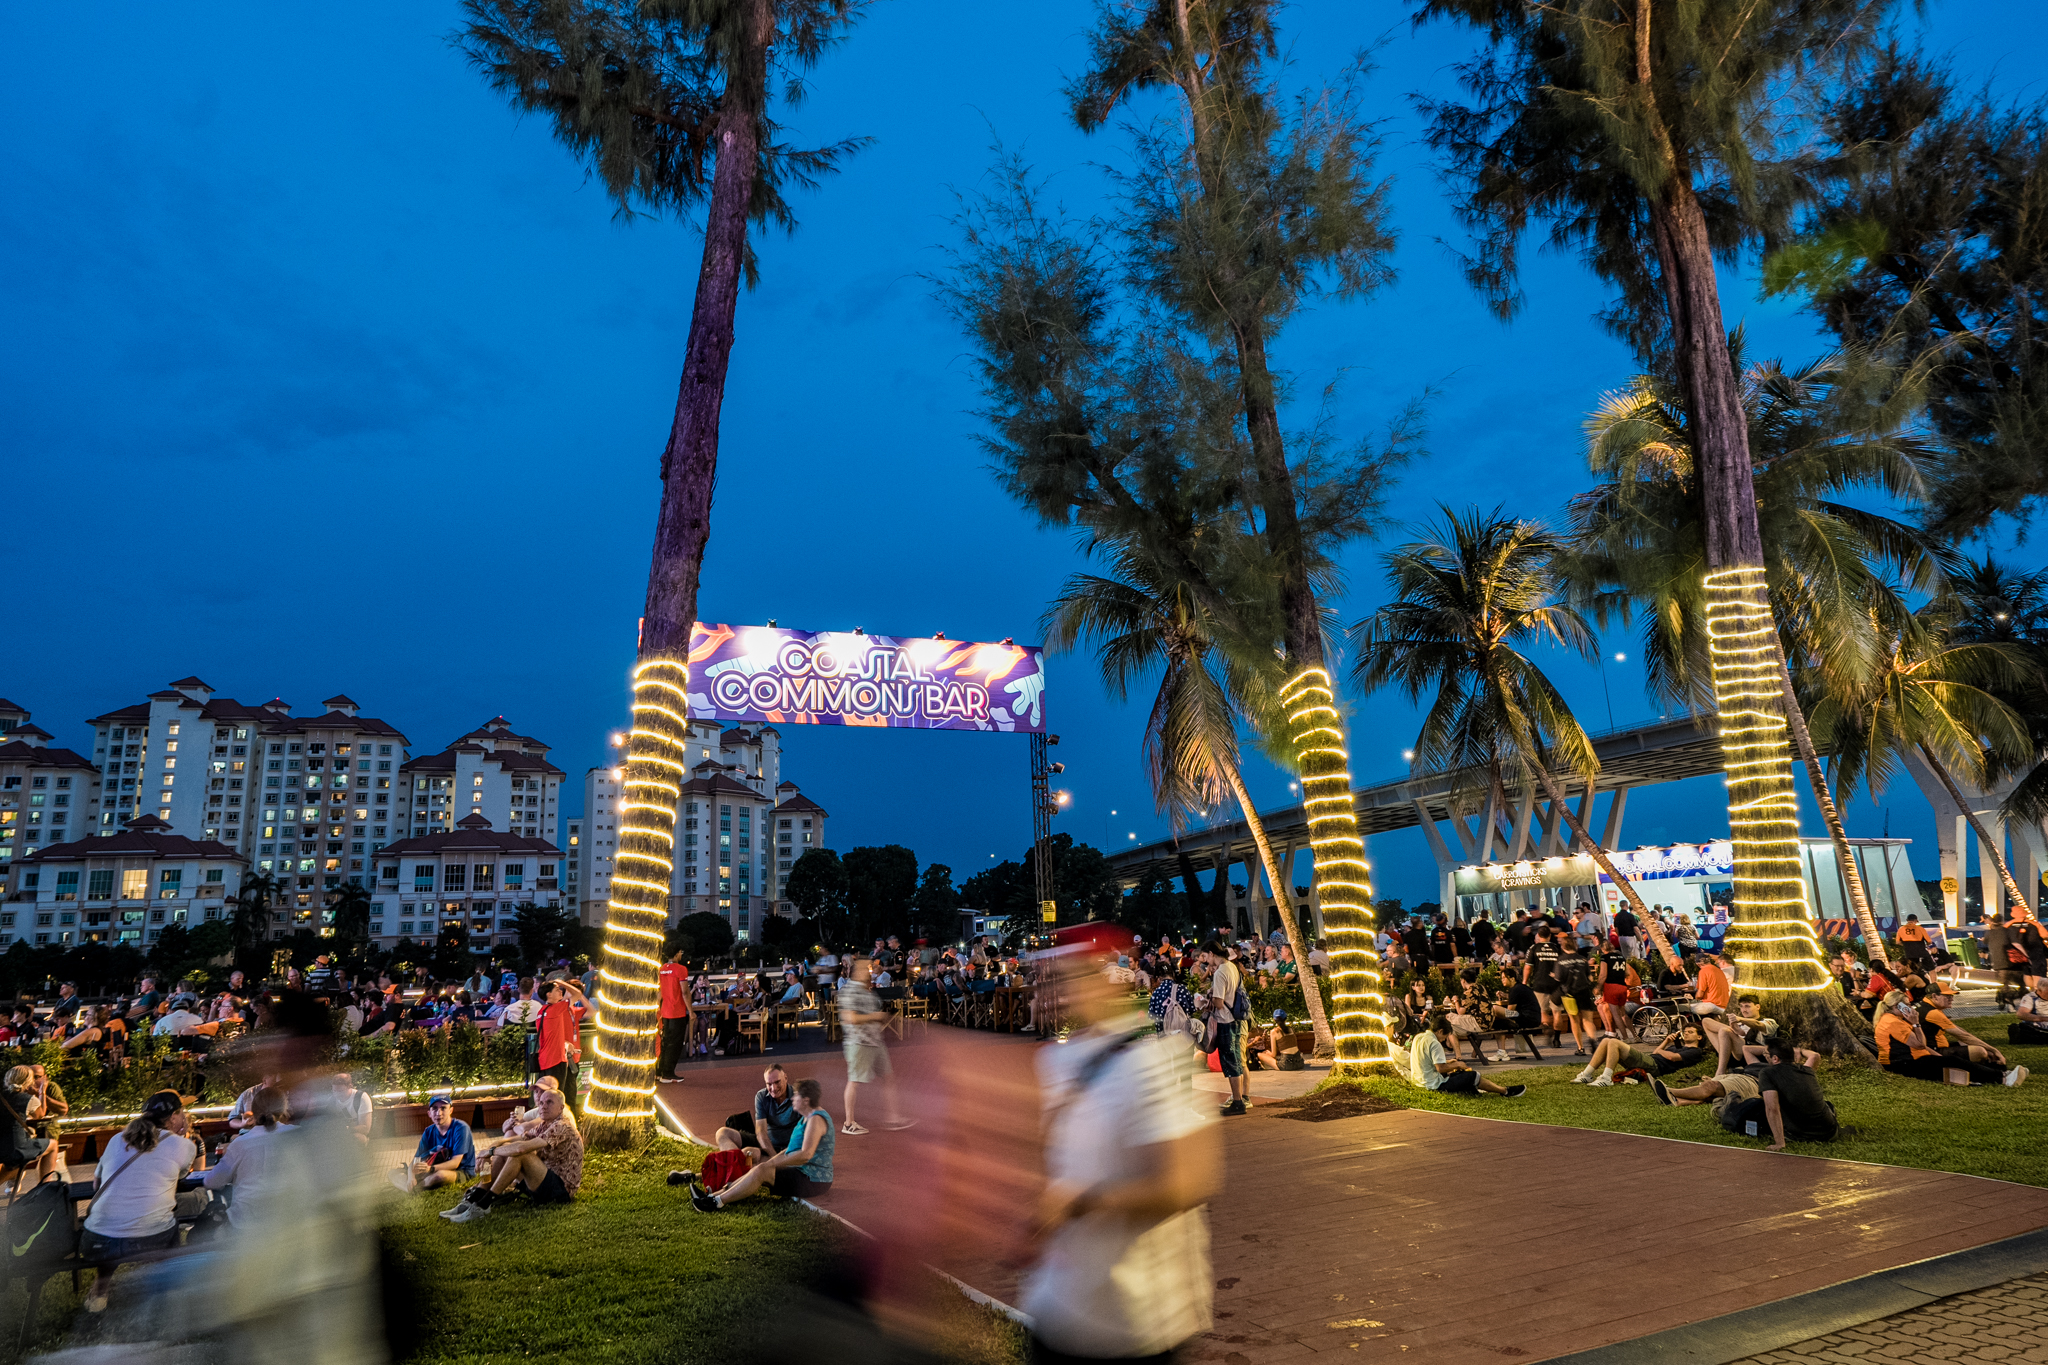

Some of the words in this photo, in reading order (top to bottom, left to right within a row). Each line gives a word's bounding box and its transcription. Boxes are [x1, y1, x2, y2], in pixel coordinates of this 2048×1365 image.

[779, 642, 931, 683] COASTAL
[716, 673, 919, 714] COMMONS
[925, 684, 987, 718] BAR
[1505, 876, 1541, 887] CRAVINGS
[1612, 961, 1626, 971] 44
